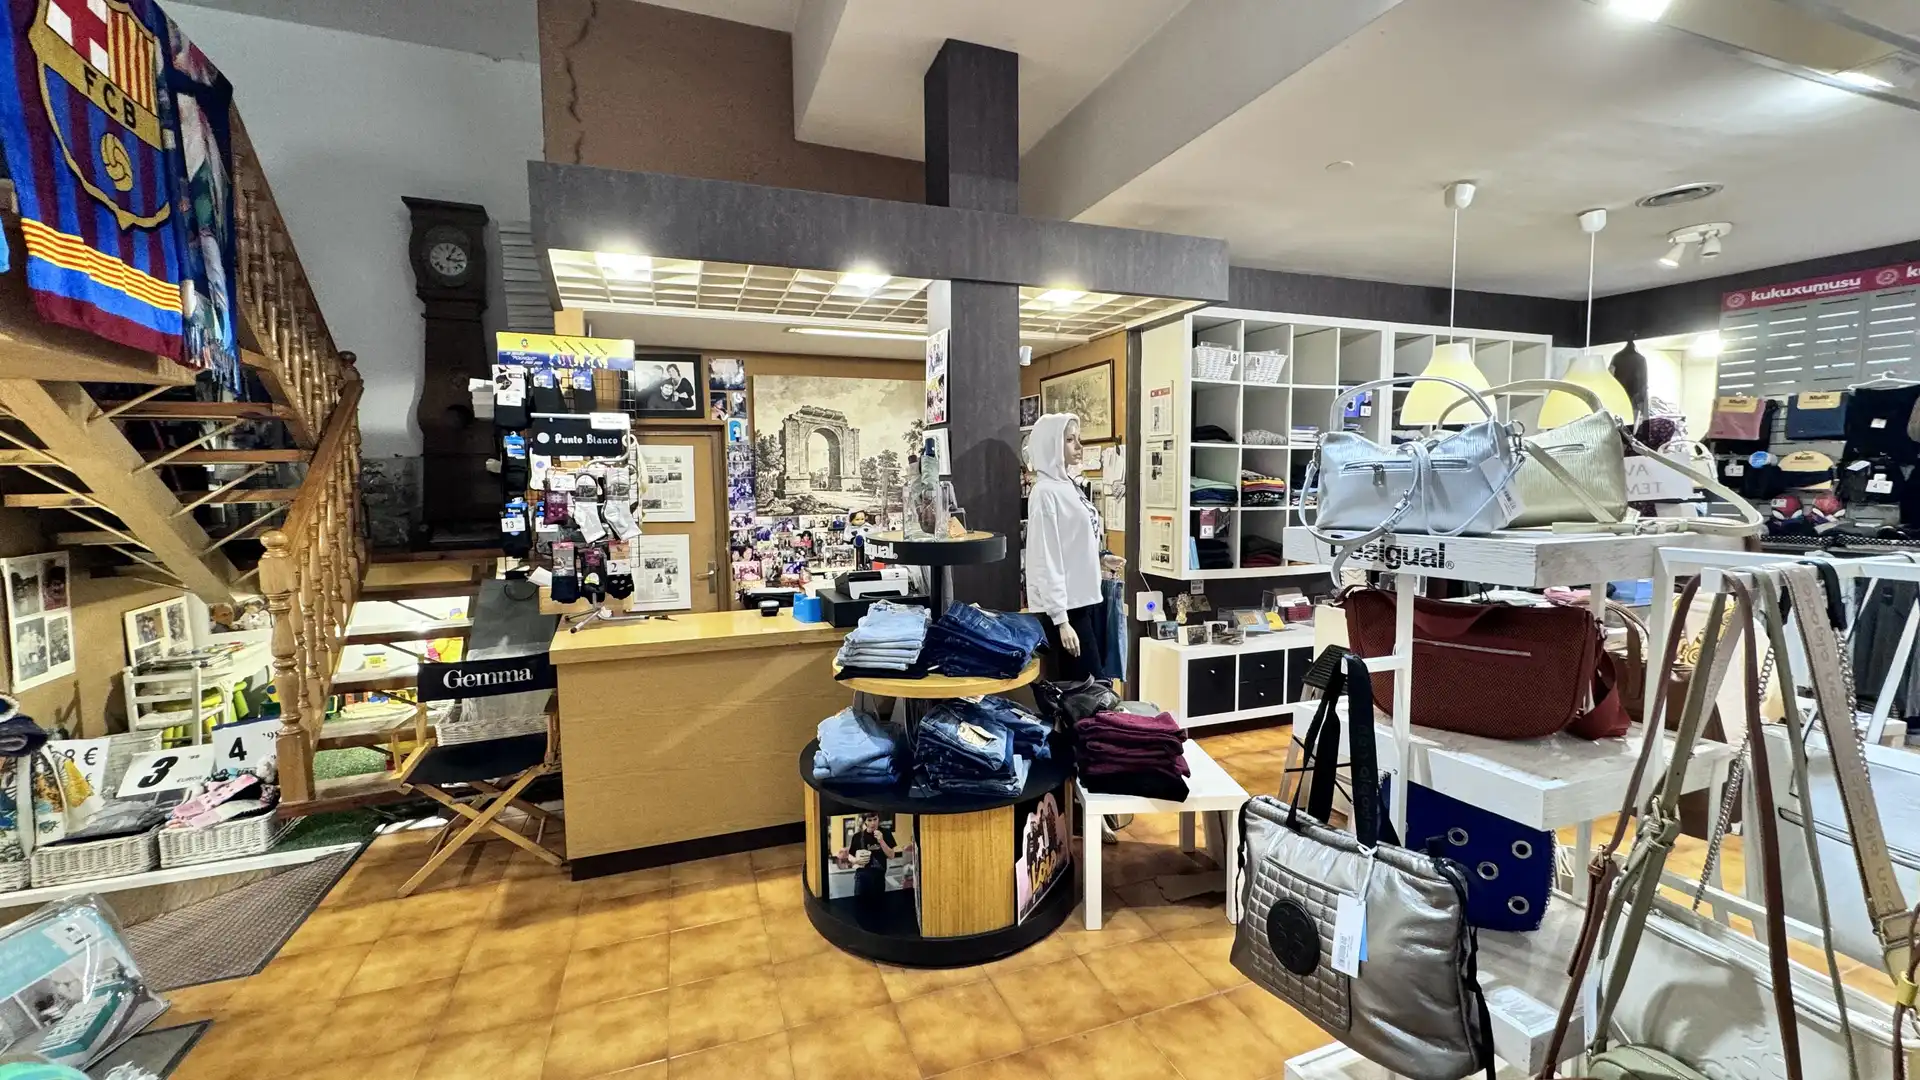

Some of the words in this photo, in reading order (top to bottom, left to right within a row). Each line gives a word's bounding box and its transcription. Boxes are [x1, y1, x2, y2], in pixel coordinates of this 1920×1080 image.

[1751, 277, 1861, 301] kukuxumusu
[554, 433, 583, 444] Punto
[586, 433, 618, 445] Blanco
[505, 520, 514, 529] 13
[443, 667, 533, 689] Gemma
[84, 747, 99, 766] €
[229, 737, 248, 762] 4
[137, 756, 179, 789] 3
